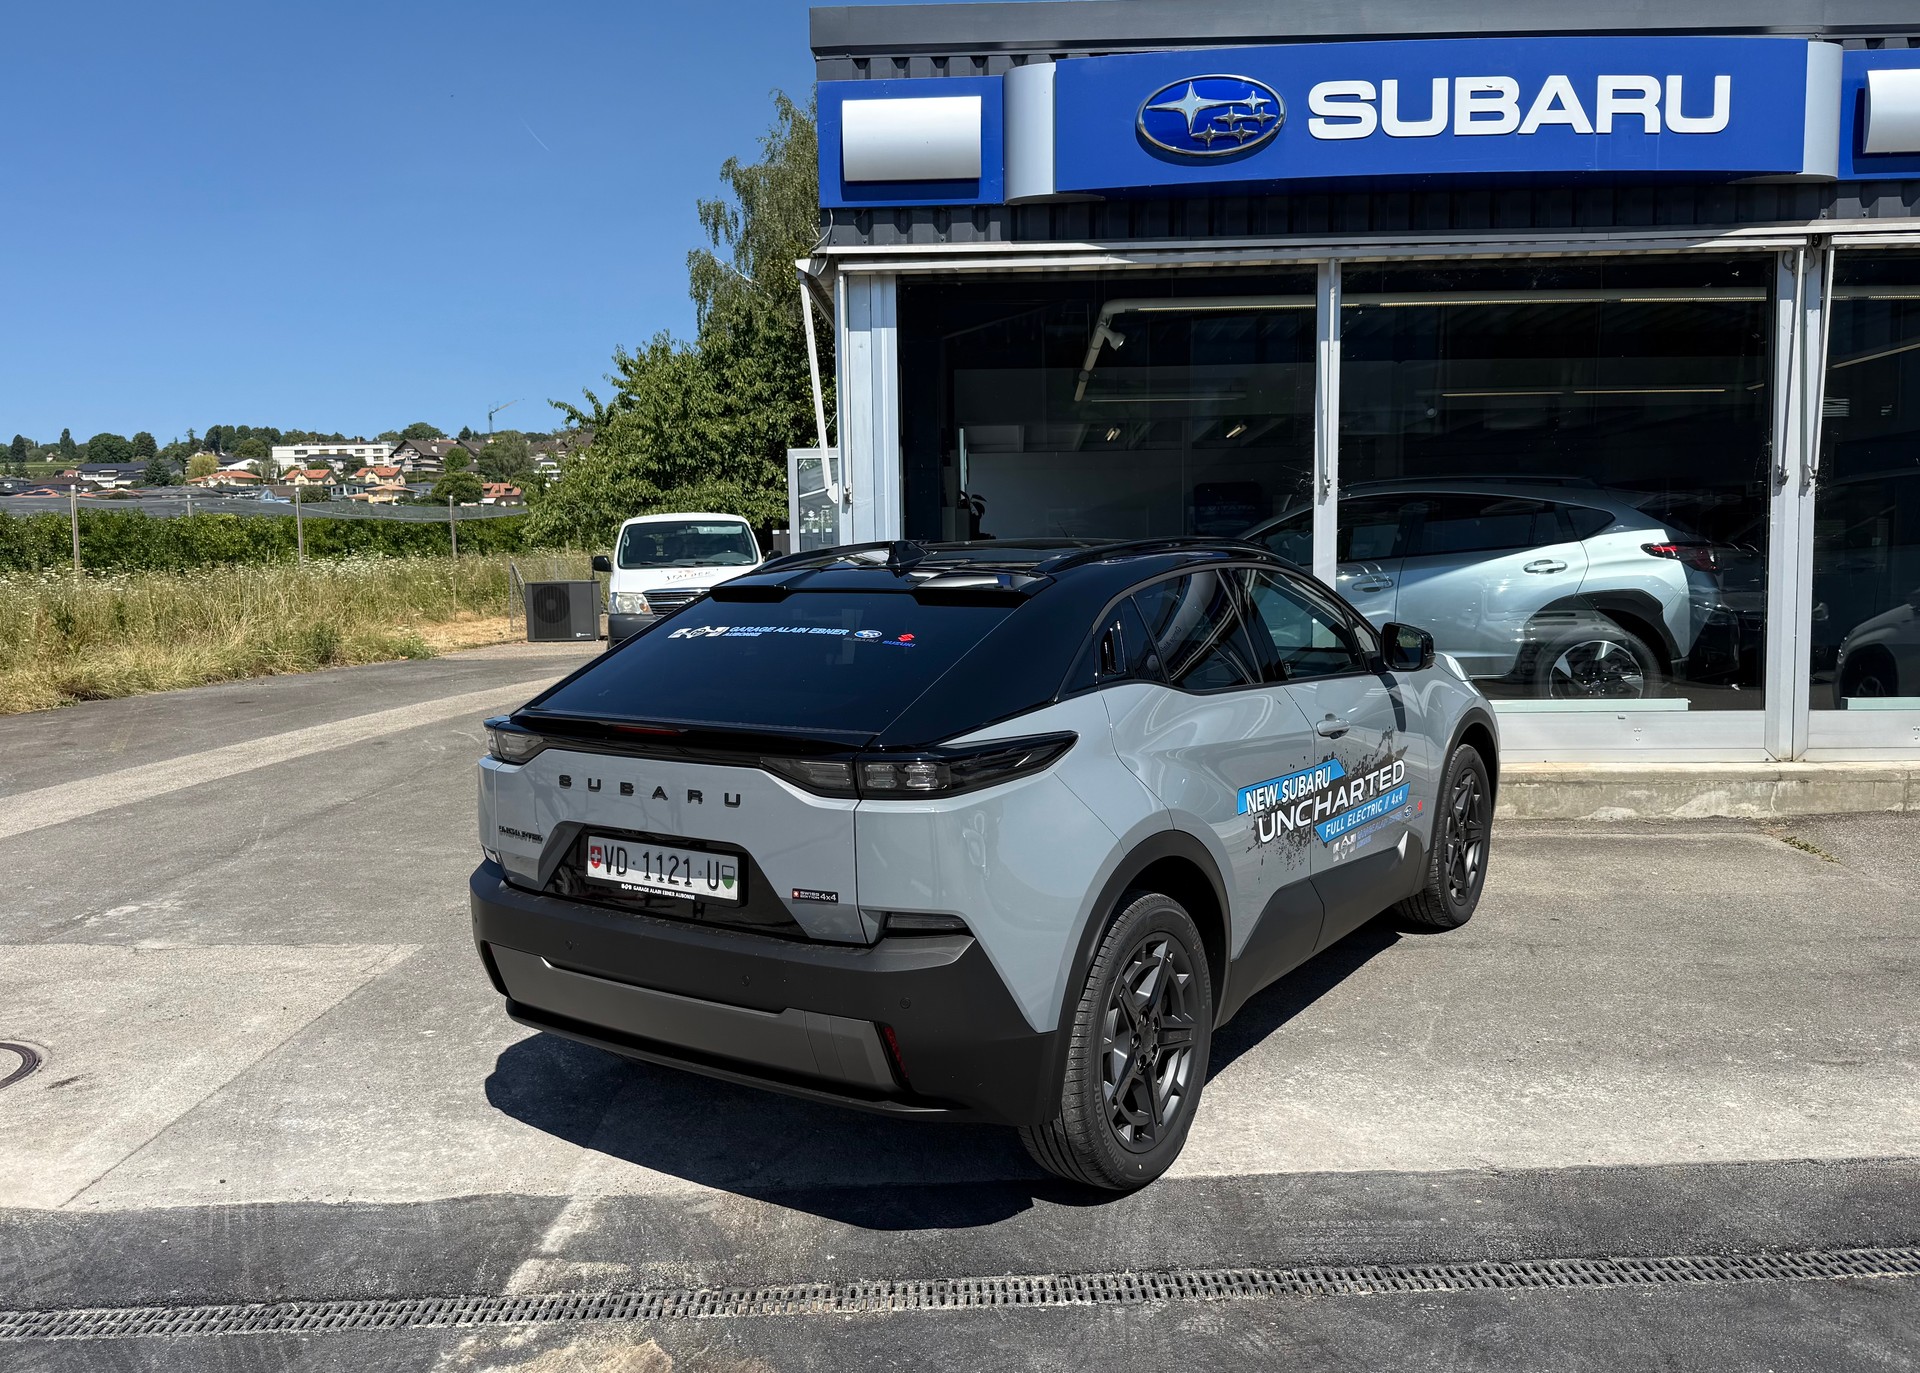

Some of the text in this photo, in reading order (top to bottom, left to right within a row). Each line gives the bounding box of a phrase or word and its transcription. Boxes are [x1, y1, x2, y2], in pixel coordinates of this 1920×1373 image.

[1308, 75, 1731, 140] SUBARU
[808, 627, 850, 636] EBNER
[882, 640, 916, 648] SUZUKI
[558, 774, 741, 808] SUBARU
[1245, 765, 1332, 816] NEW SUBARU
[1257, 759, 1406, 844] UNCHARTED
[1325, 818, 1345, 838] FULL
[1346, 800, 1383, 828] ELECTRIC
[1391, 789, 1403, 805] 4x4
[603, 844, 720, 891] VD 1121 U
[633, 885, 650, 893] GARAGE
[820, 893, 837, 901] 4x4
